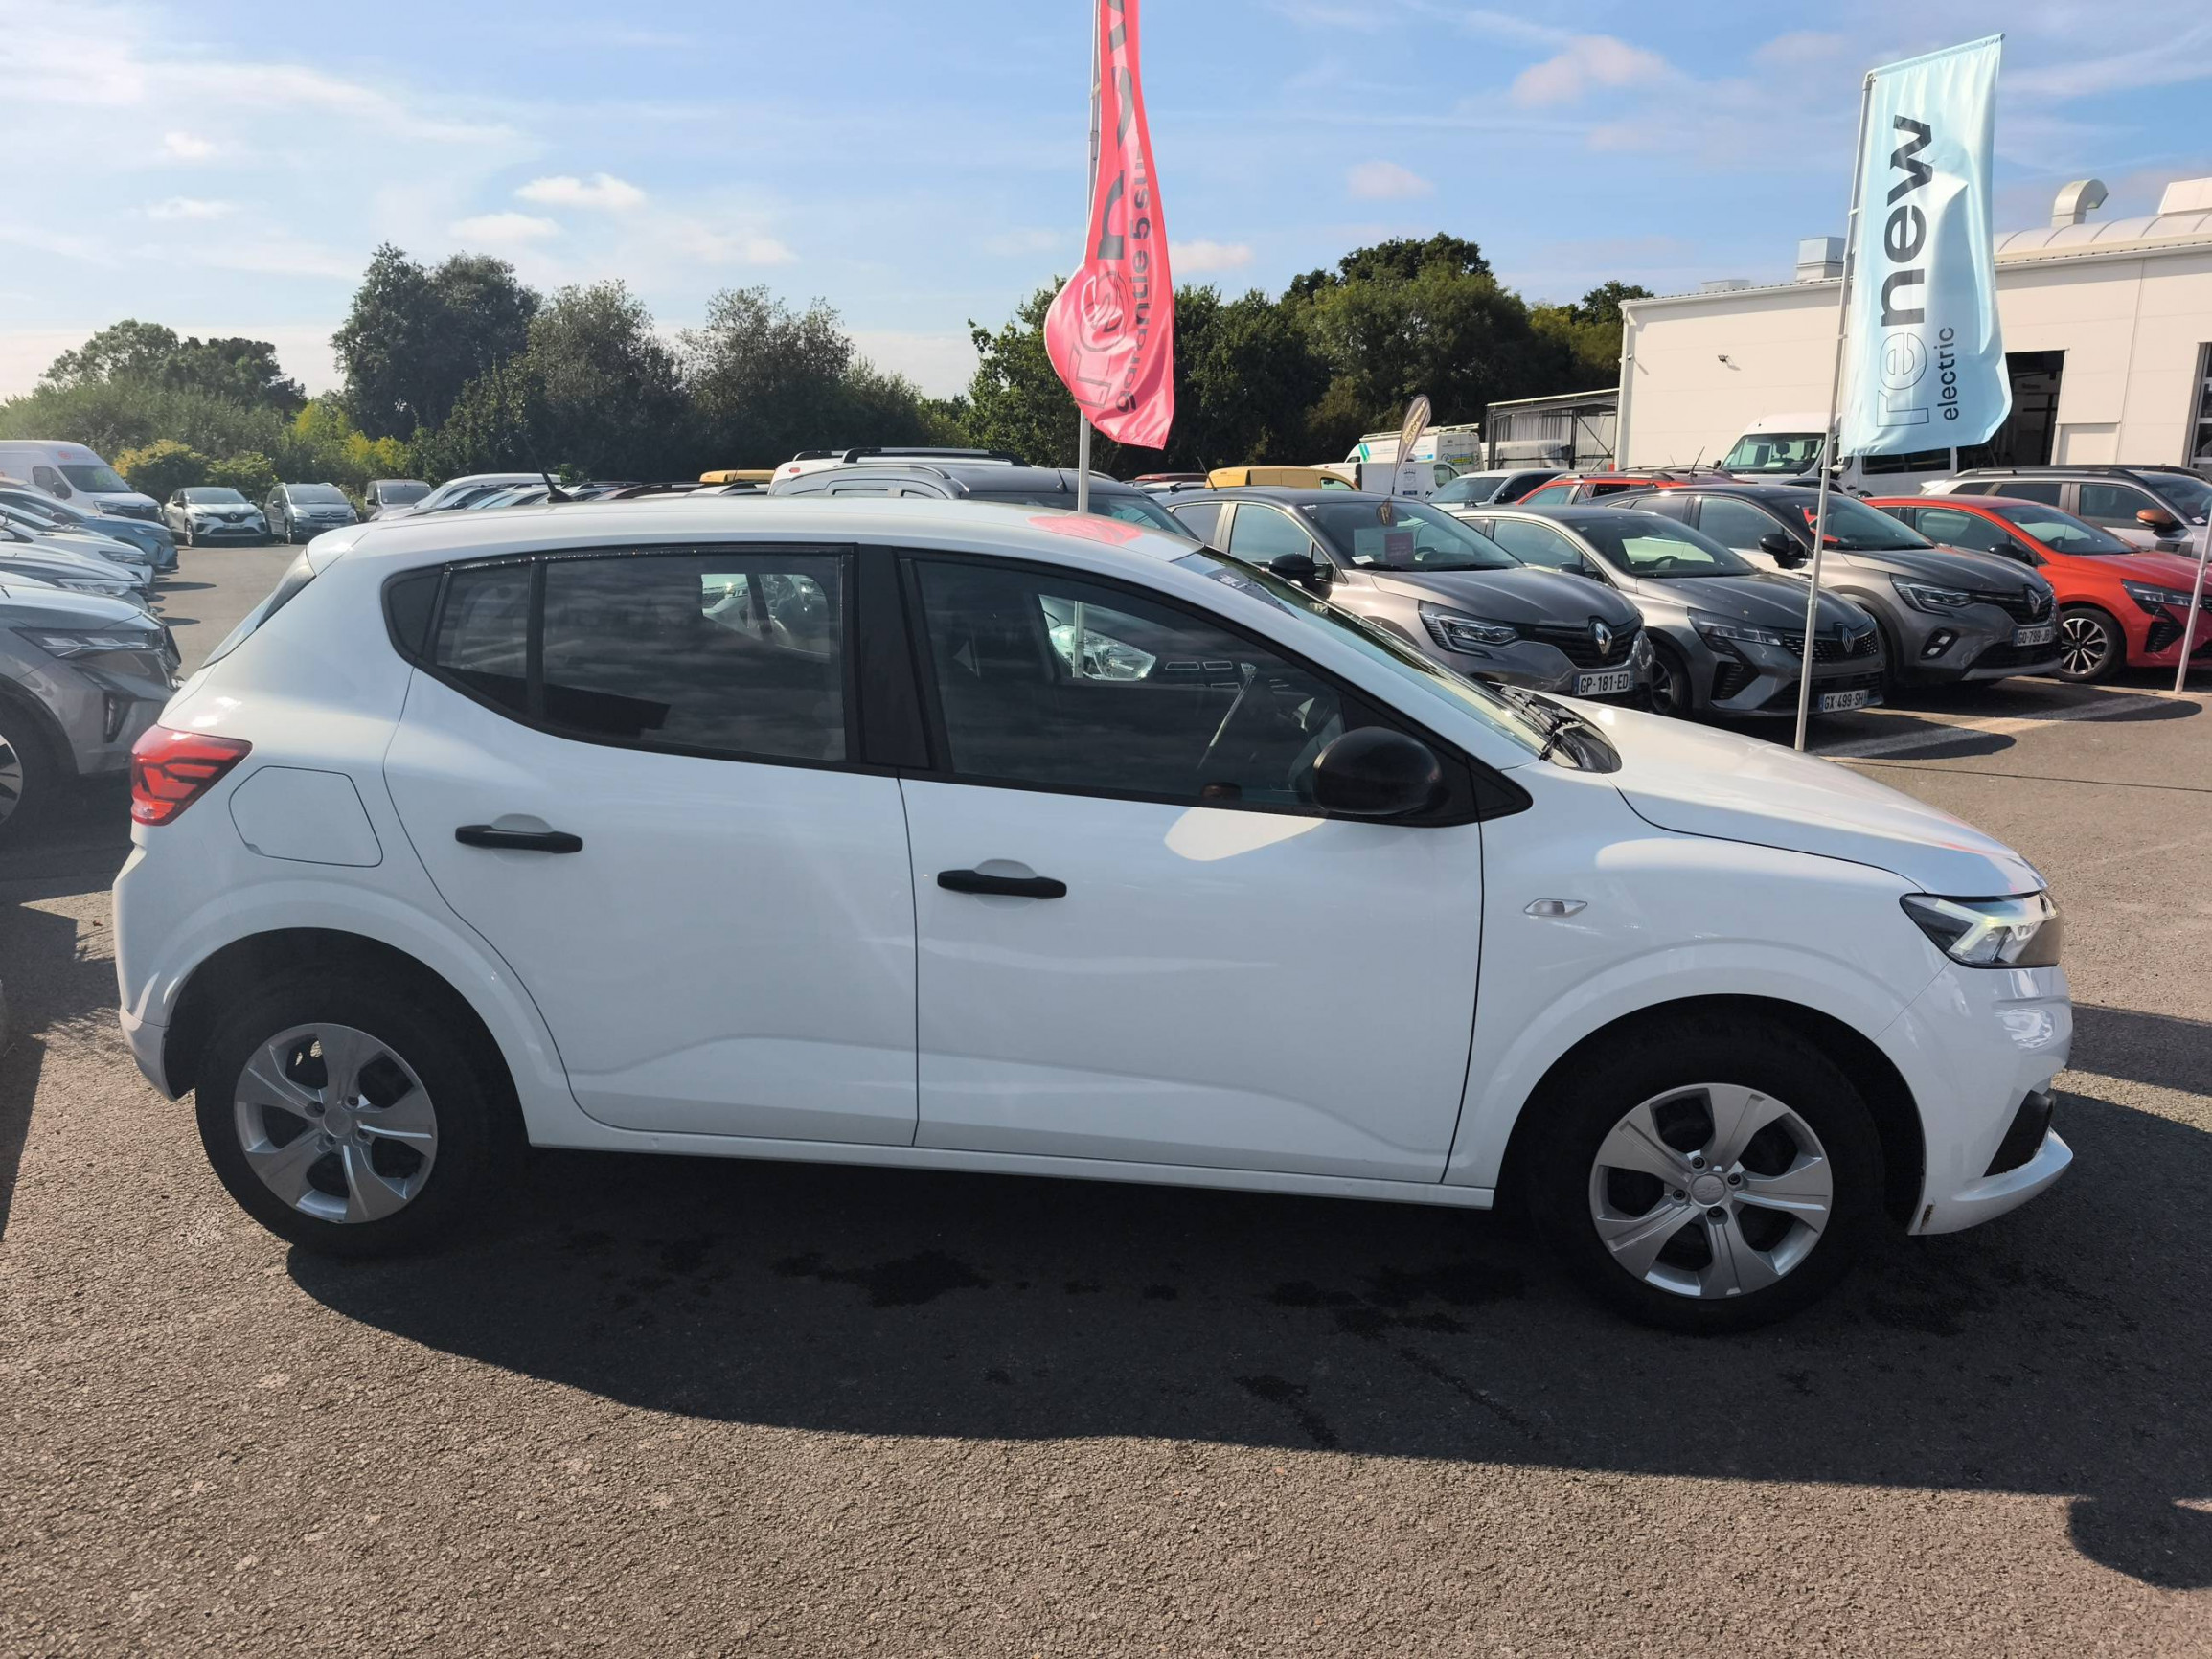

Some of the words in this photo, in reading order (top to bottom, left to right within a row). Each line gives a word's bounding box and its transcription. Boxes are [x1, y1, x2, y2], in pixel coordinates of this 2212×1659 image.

[1129, 217, 1150, 239] 5
[1877, 115, 1933, 427] renew
[1116, 250, 1150, 412] garantie
[1934, 326, 1959, 421] electric
[1580, 673, 1629, 693] GP-181-ED
[1824, 693, 1864, 710] GX-499-SH
